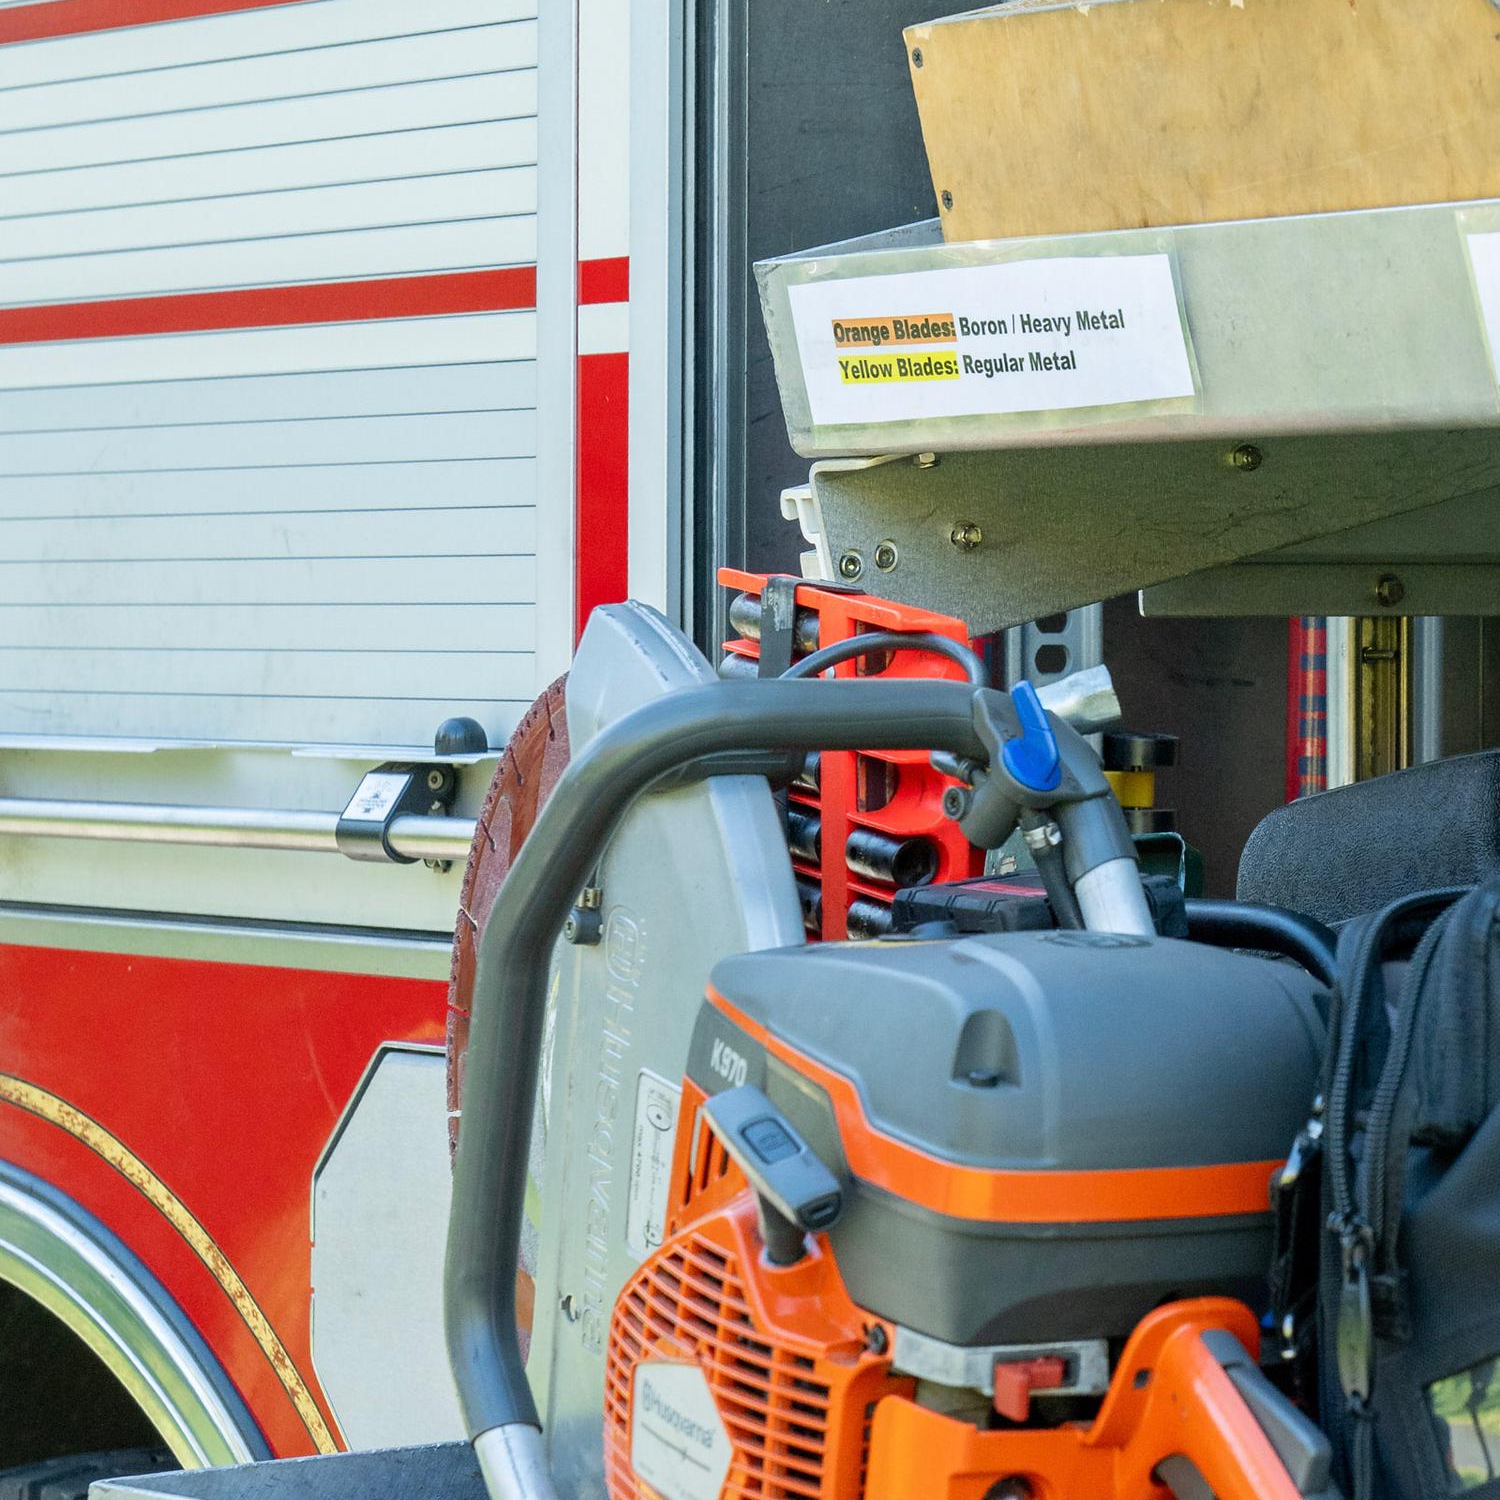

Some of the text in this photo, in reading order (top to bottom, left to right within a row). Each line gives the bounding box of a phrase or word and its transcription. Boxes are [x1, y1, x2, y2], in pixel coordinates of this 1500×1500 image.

[832, 322, 890, 347] Orange
[892, 317, 957, 341] Blades:
[959, 316, 1009, 338] Boron
[1019, 313, 1072, 338] Heavy
[1075, 308, 1126, 332] Metal
[838, 350, 1078, 380] Yellow Blades: Regular Metal
